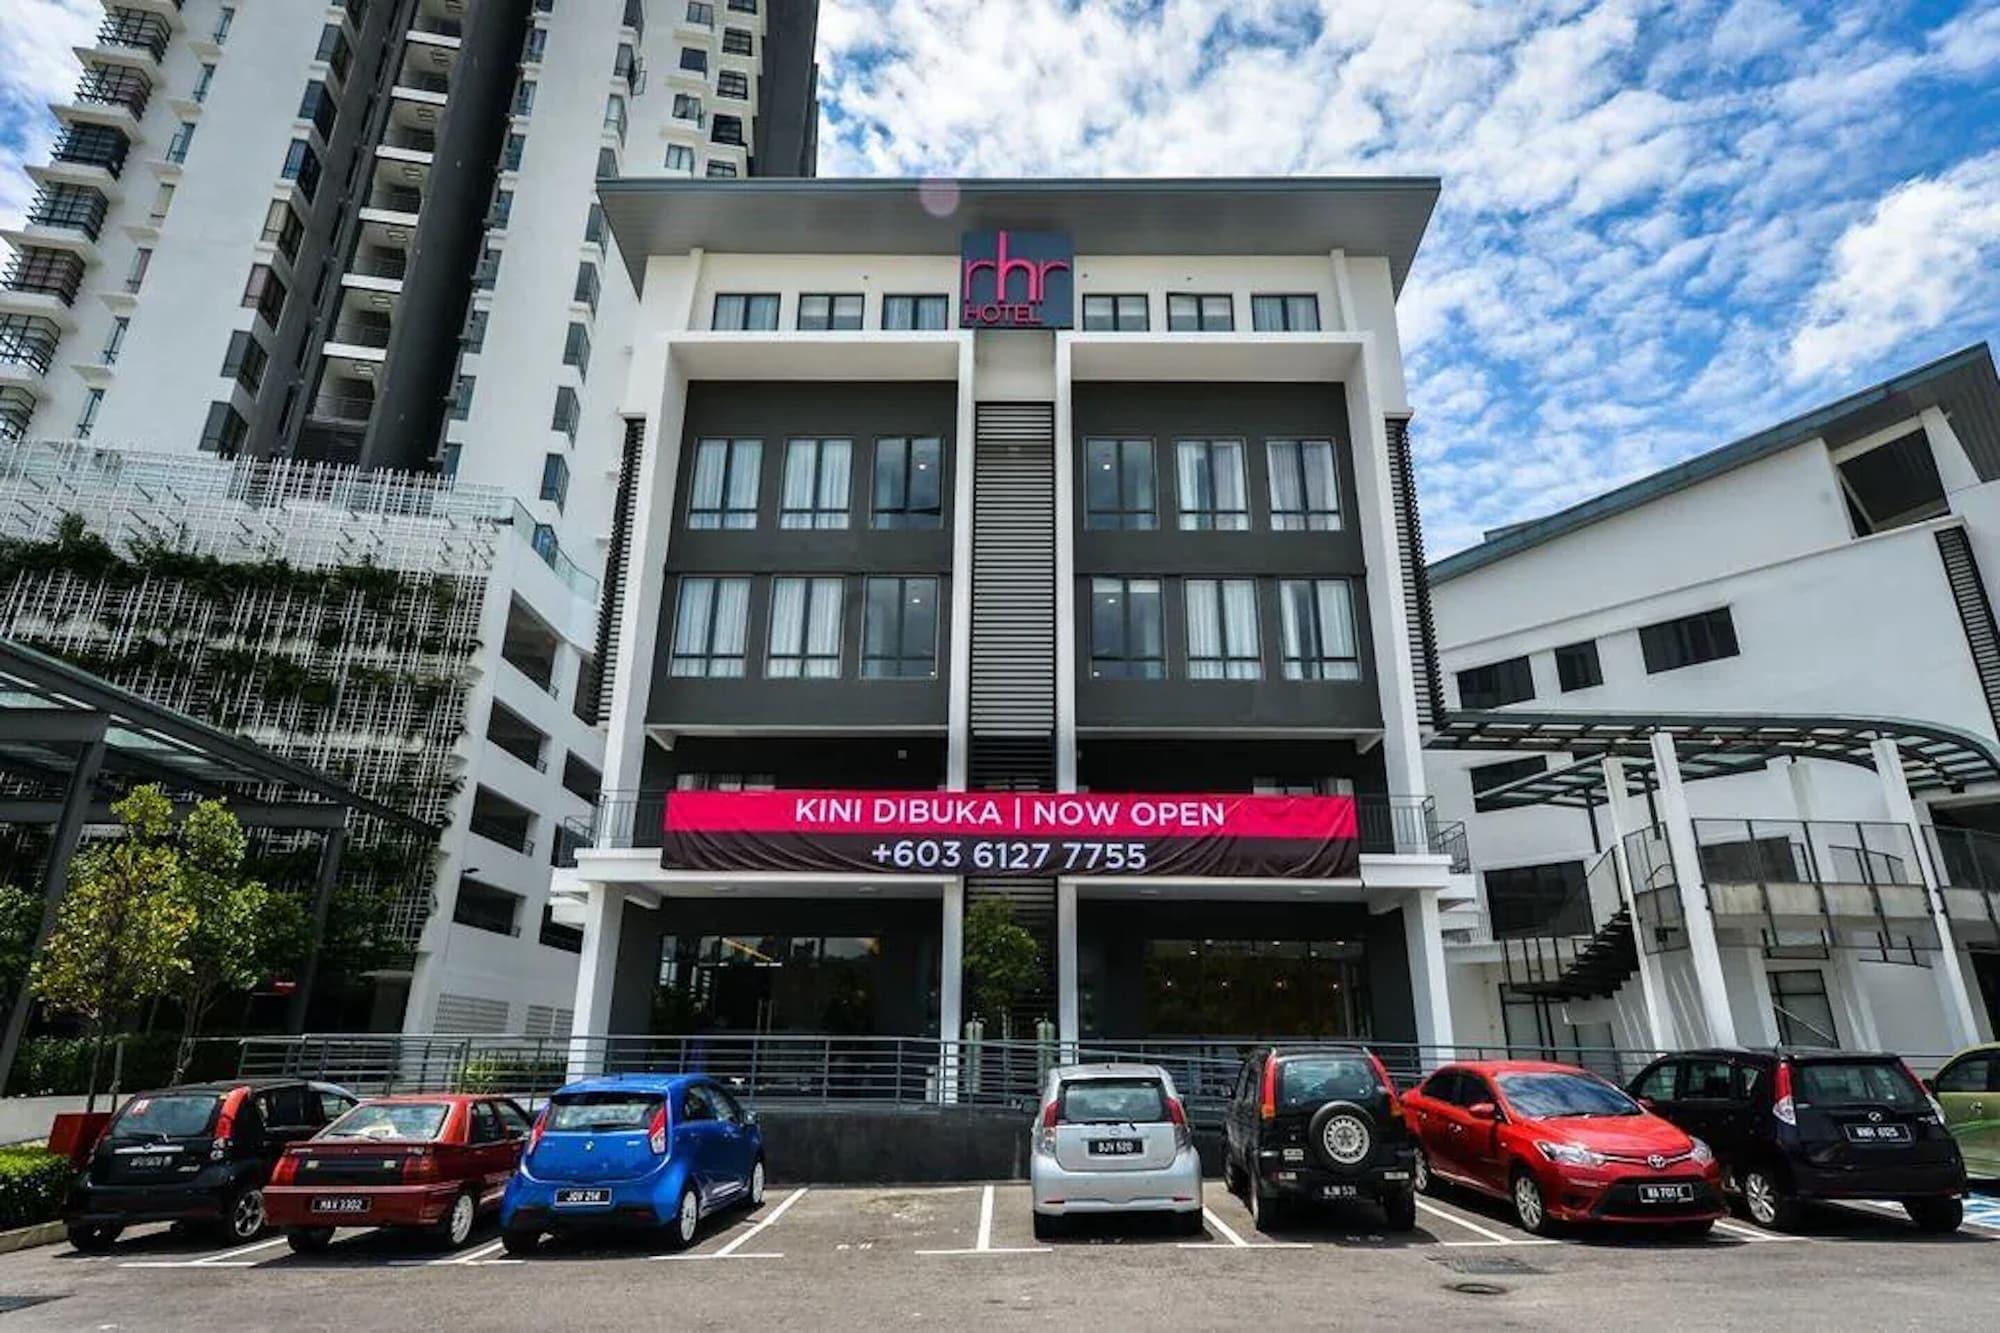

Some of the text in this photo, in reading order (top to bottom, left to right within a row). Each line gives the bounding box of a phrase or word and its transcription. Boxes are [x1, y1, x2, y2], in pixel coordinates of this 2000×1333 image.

[964, 230, 1070, 301] rhr
[964, 303, 1043, 323] HOTEL
[795, 798, 861, 823] KINI
[873, 799, 1002, 825] DIBUKA
[1033, 801, 1120, 826] NOW
[1130, 801, 1226, 827] OPEN
[872, 840, 1147, 870] +603 6127 7755
